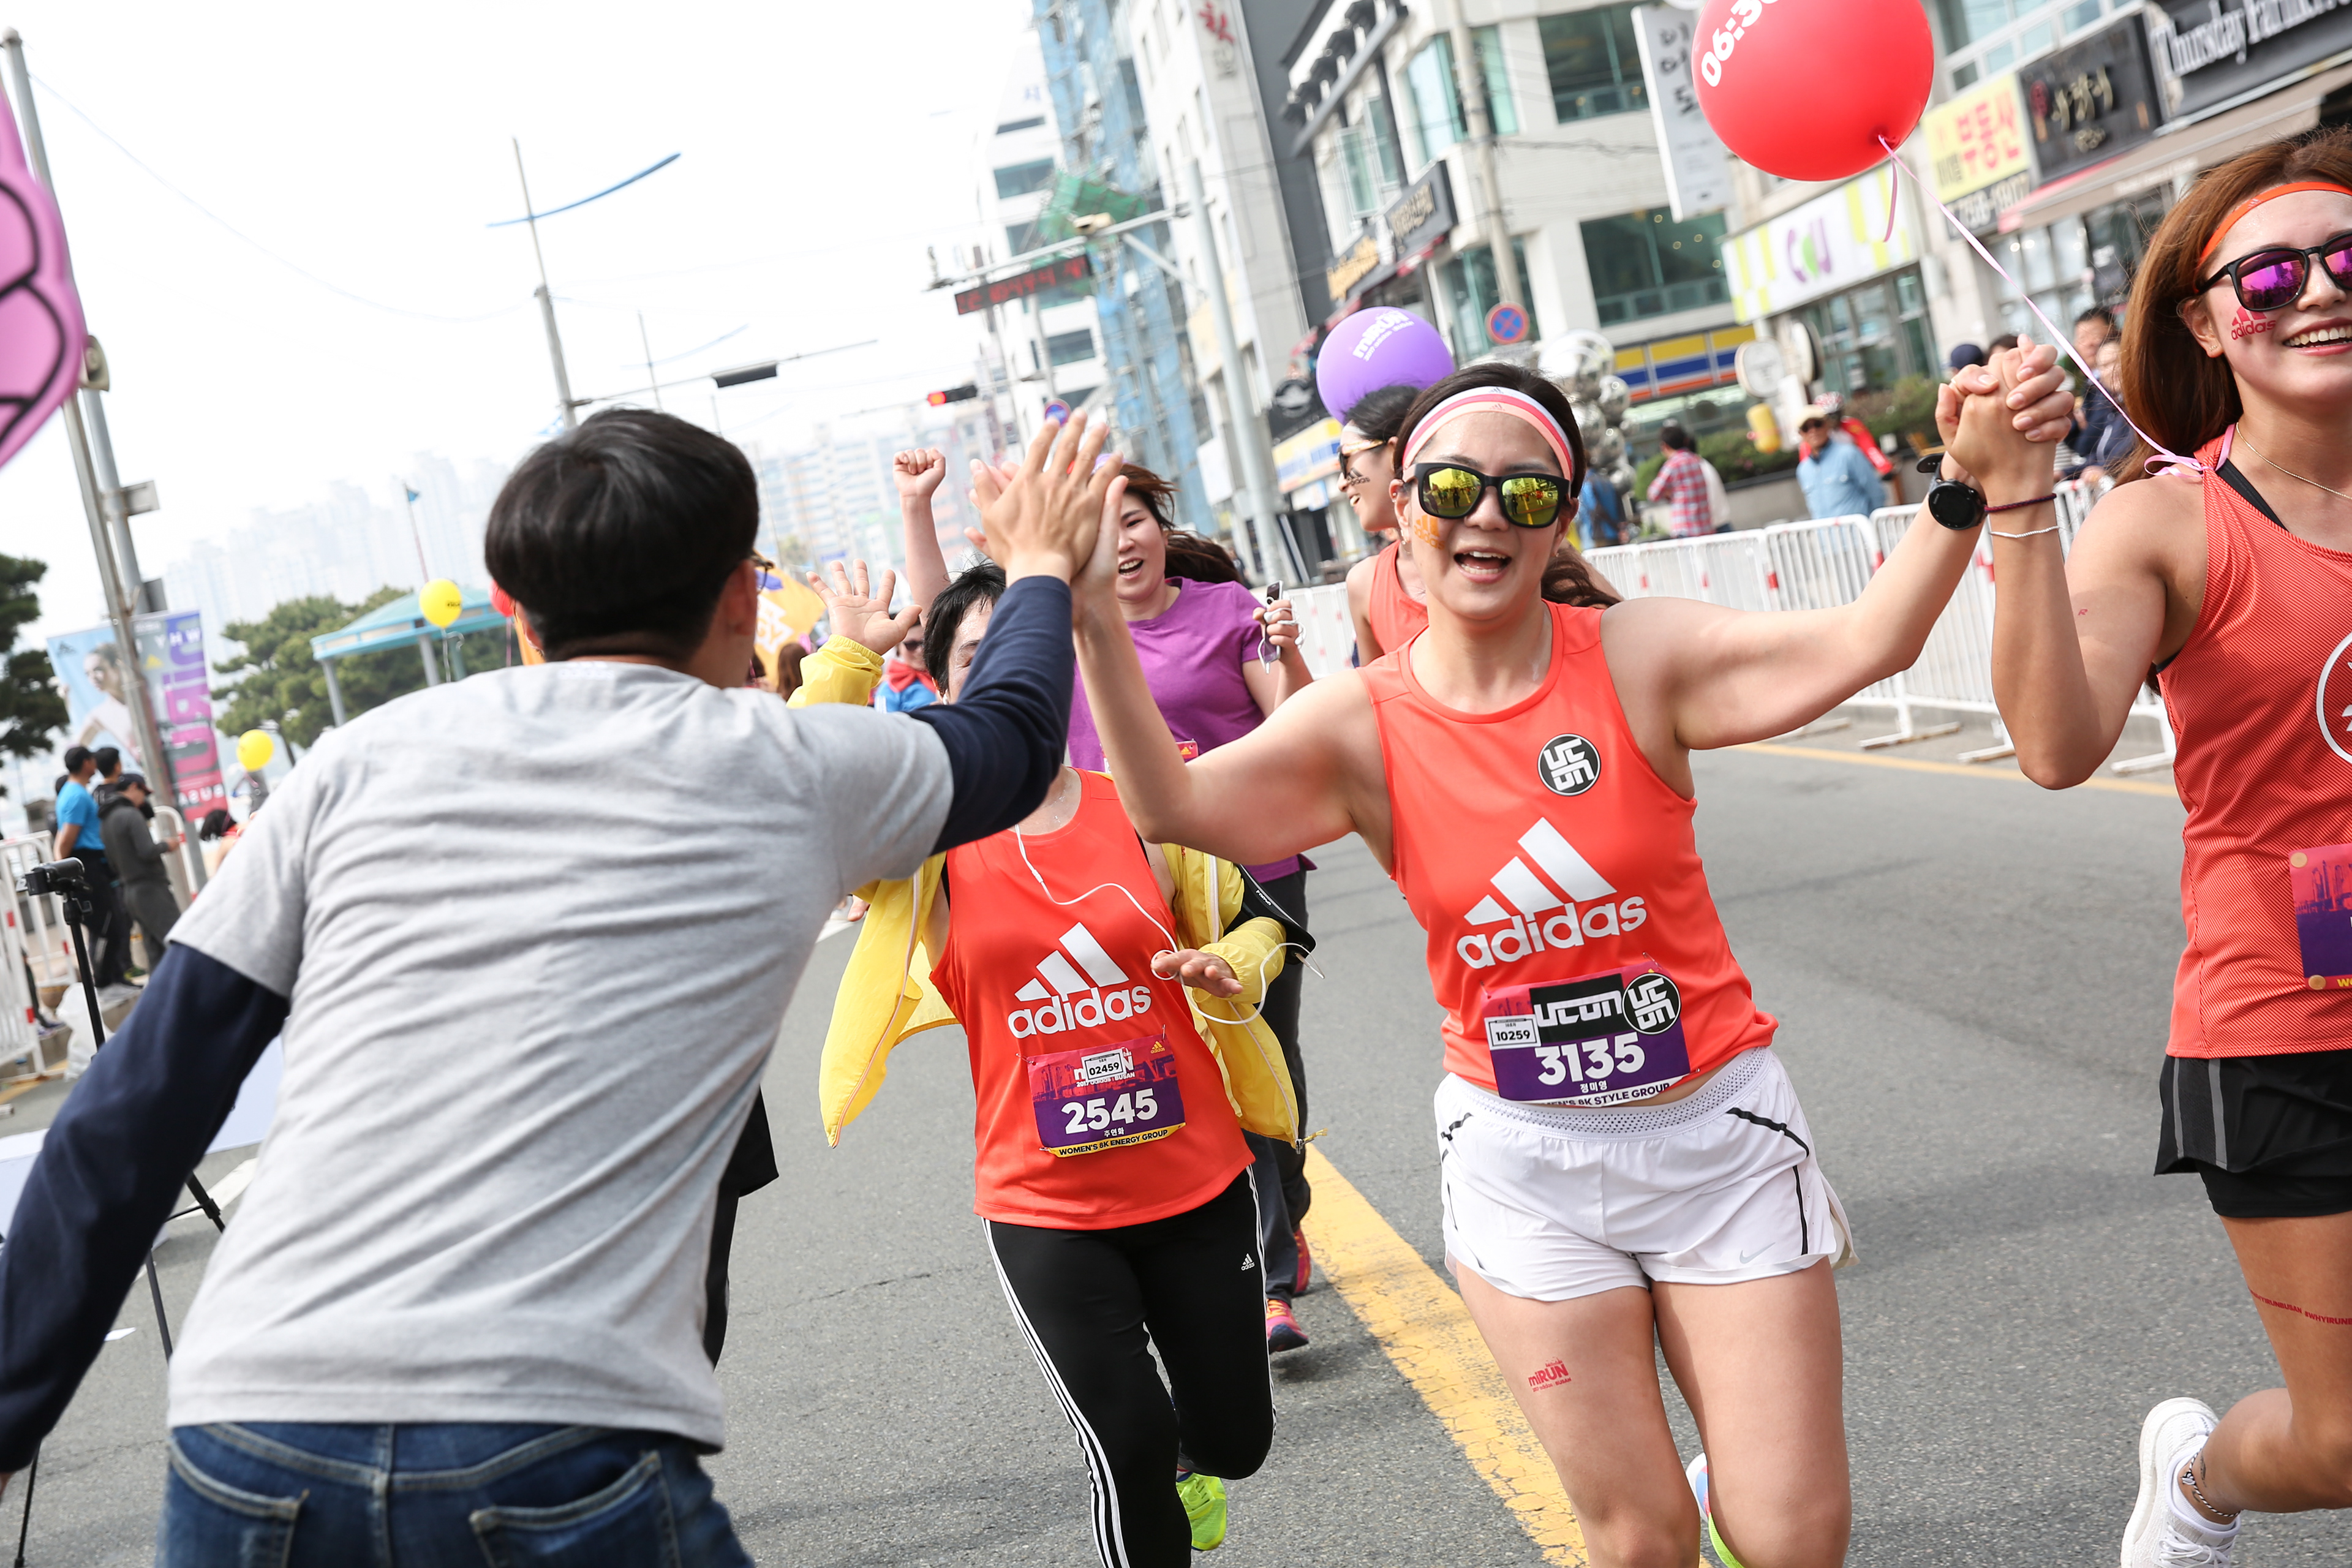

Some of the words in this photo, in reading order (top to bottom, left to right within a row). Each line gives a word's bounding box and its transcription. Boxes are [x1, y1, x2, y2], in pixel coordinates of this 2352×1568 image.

[1701, 0, 1777, 88] 06:3
[2231, 320, 2277, 340] adidas
[1414, 524, 1446, 550] adidas
[1457, 895, 1648, 970] adidas
[1008, 986, 1152, 1038] adidas
[1496, 1030, 1531, 1041] 10259
[1089, 1062, 1120, 1076] 02459
[1534, 1031, 1645, 1085] 3135
[1115, 1072, 1135, 1081] BUSAN
[1580, 1080, 1608, 1093] 정미영
[1594, 1091, 1629, 1105] STYLE
[1631, 1082, 1670, 1098] GROUP
[1061, 1088, 1158, 1134] 2545
[1059, 1144, 1098, 1155] WOMEN'S
[1110, 1136, 1140, 1146] ENERGY
[1142, 1129, 1167, 1140] GROUP
[1528, 1363, 1569, 1387] miRUN
